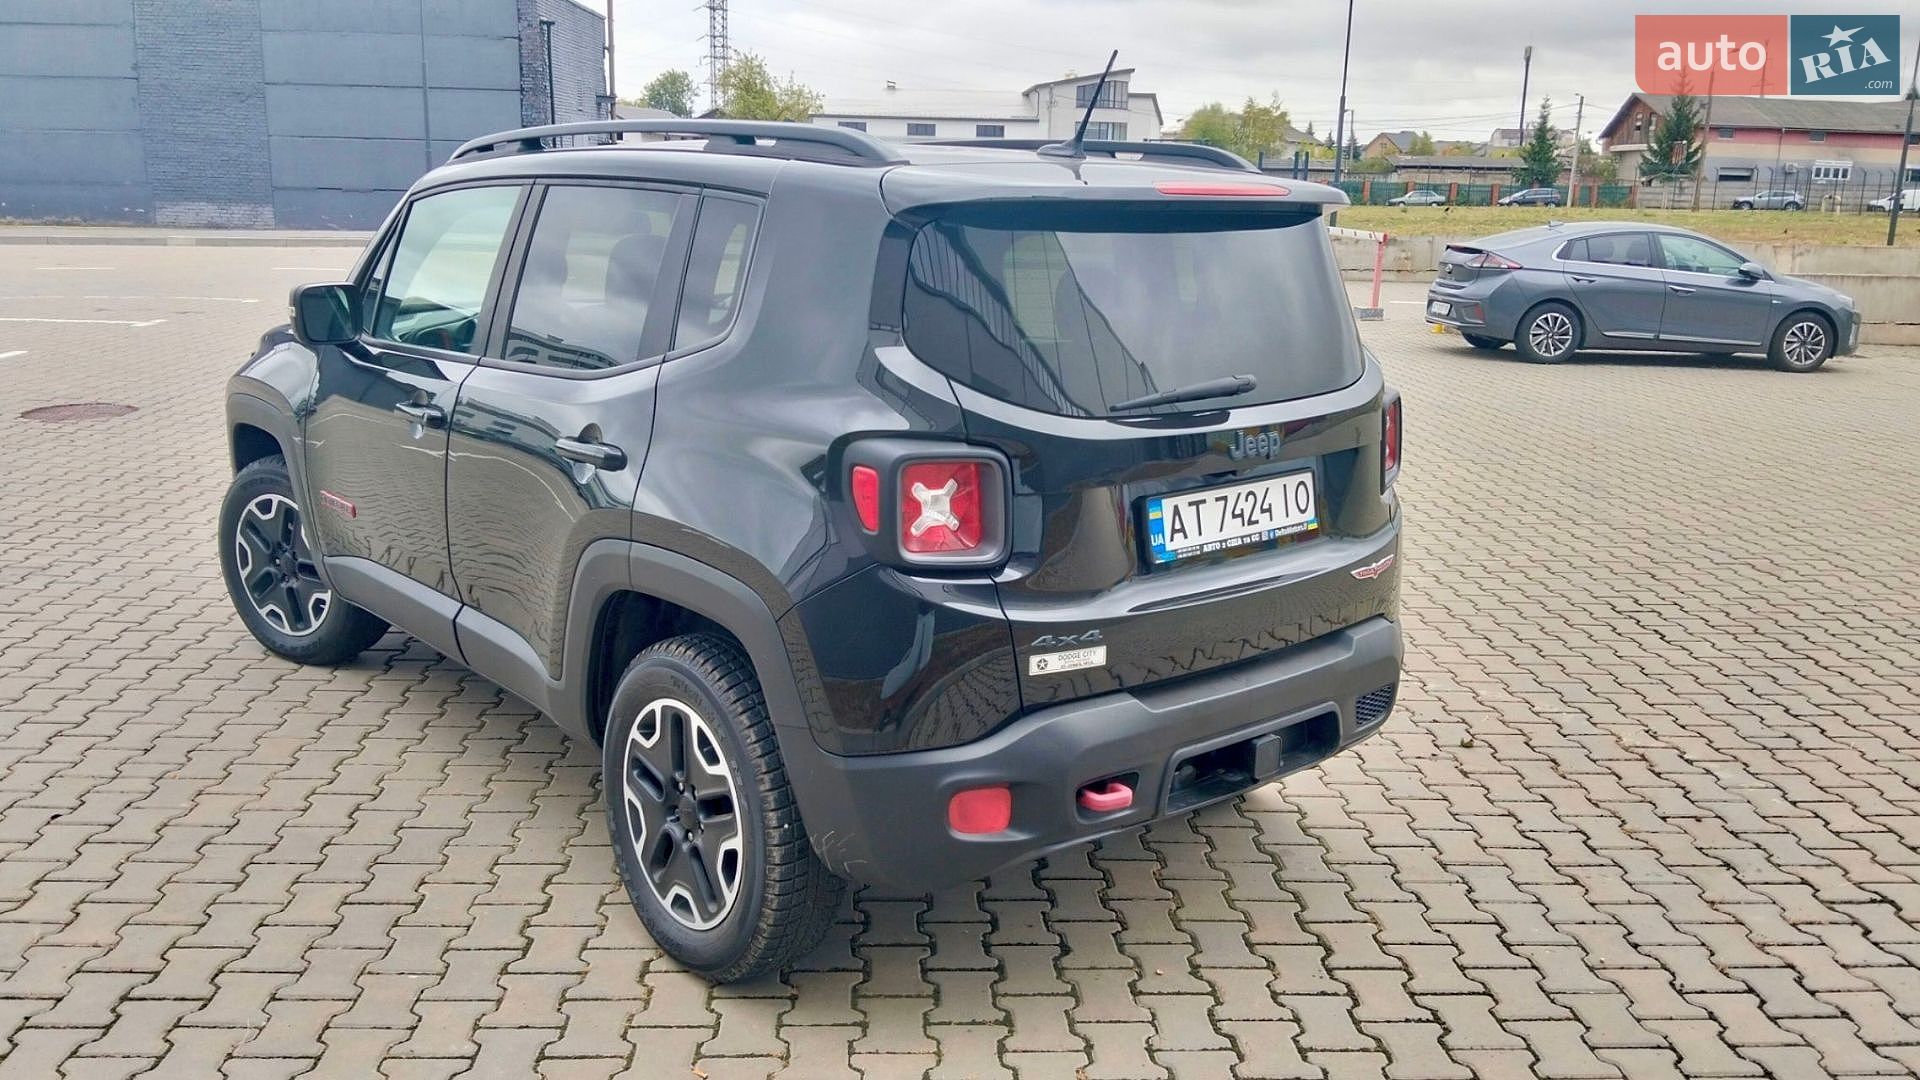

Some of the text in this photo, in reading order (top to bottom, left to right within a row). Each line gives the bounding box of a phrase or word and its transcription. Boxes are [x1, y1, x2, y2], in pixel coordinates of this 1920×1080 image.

[1229, 429, 1281, 461] Jeep
[1169, 480, 1310, 542] AT 7424 IO
[1150, 533, 1165, 546] UA
[1031, 629, 1103, 646] 4x4
[1058, 648, 1097, 661] DODGE CITY
